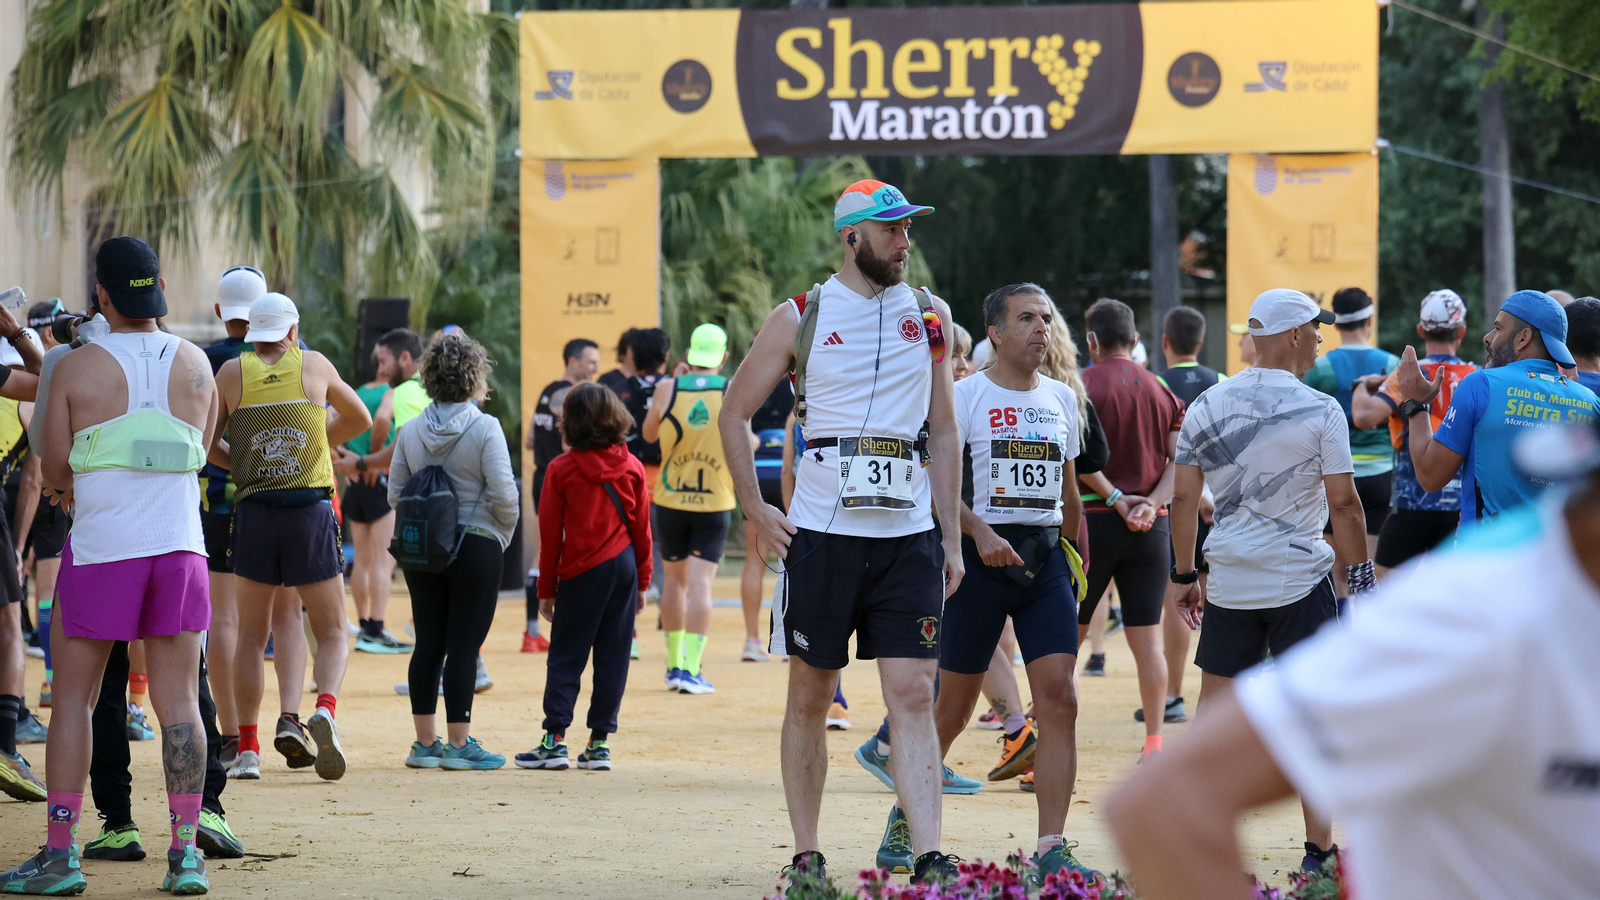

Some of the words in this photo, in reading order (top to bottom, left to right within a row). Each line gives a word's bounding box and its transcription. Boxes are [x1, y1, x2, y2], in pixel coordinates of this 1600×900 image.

[775, 17, 1101, 130] Sherry
[828, 93, 1049, 141] Maratón
[129, 277, 155, 288] NIKE
[1504, 398, 1562, 423] Sierra
[1506, 386, 1532, 399] Club
[1533, 391, 1547, 402] de
[1548, 393, 1594, 412] Montaña
[1037, 407, 1060, 417] SEVILLA
[1038, 416, 1059, 425] CORRE
[1503, 417, 1535, 428] Morón
[251, 429, 271, 448] CLUB
[271, 425, 307, 442] ATLÉTICO
[862, 438, 899, 455] Sherry
[1011, 441, 1046, 458] Sherry
[867, 459, 892, 486] 31
[1009, 462, 1047, 488] 163
